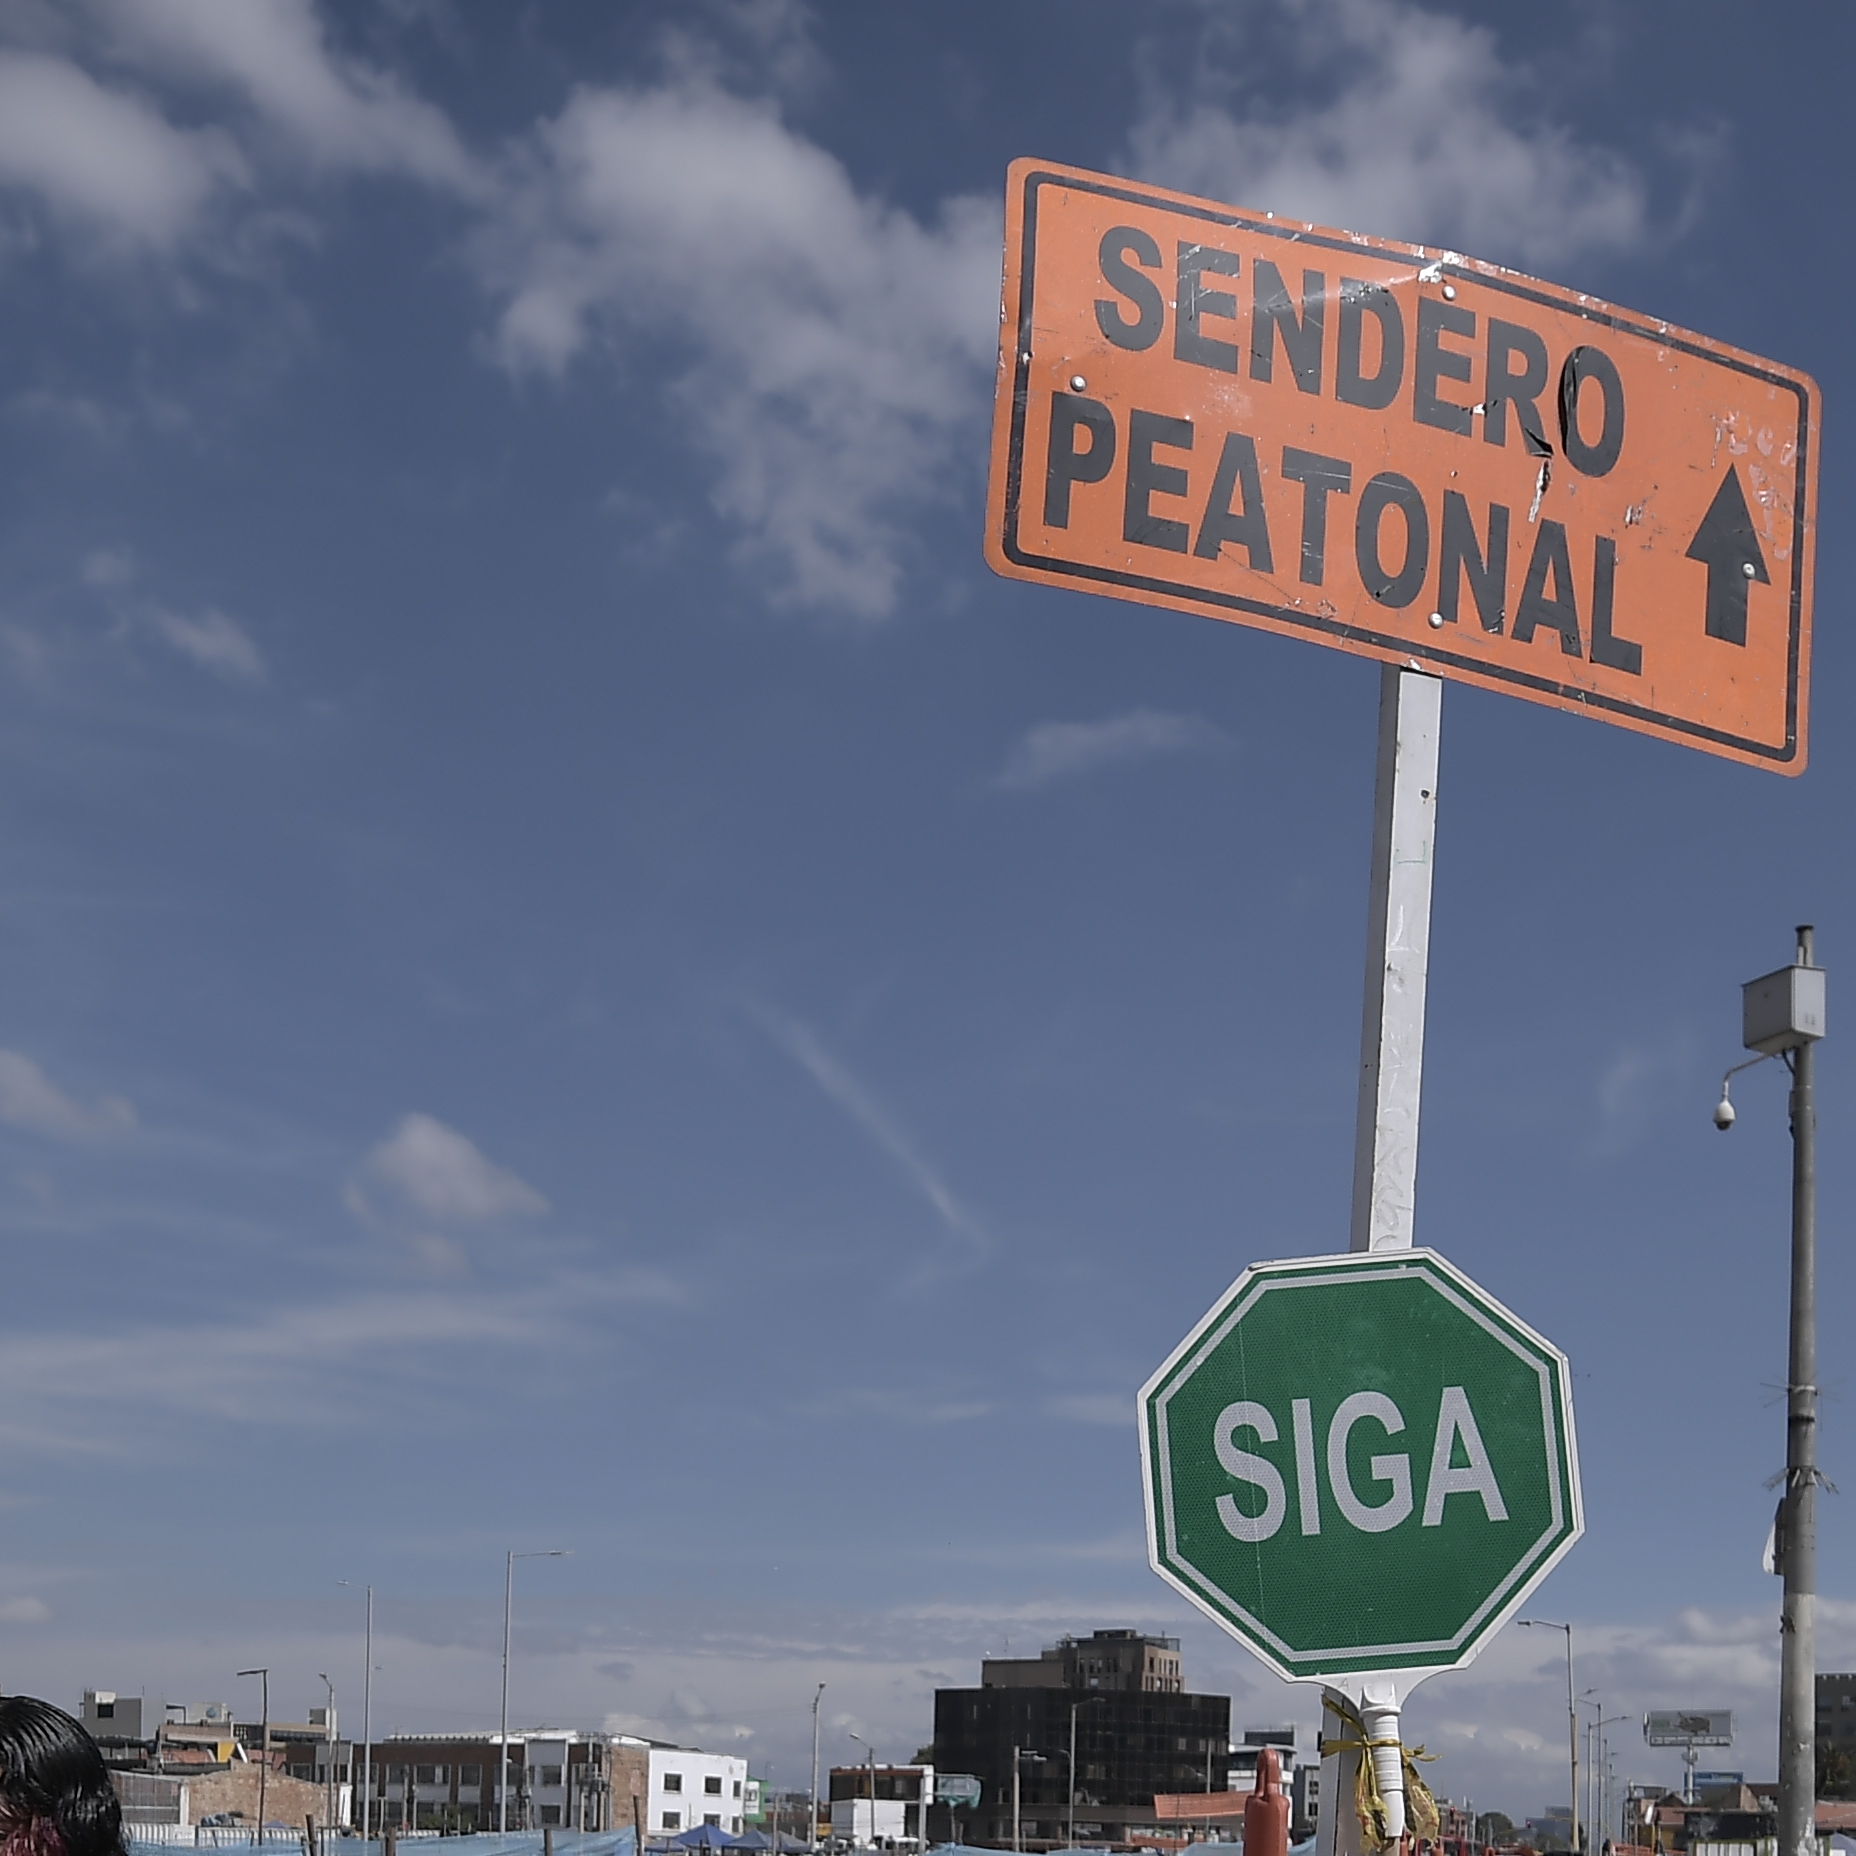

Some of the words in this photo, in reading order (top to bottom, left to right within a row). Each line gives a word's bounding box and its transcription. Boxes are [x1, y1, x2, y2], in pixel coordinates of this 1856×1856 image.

[1094, 225, 1625, 479] SENDERO
[1042, 391, 1643, 676] PEATONAL
[1213, 1386, 1510, 1543] SIGA
